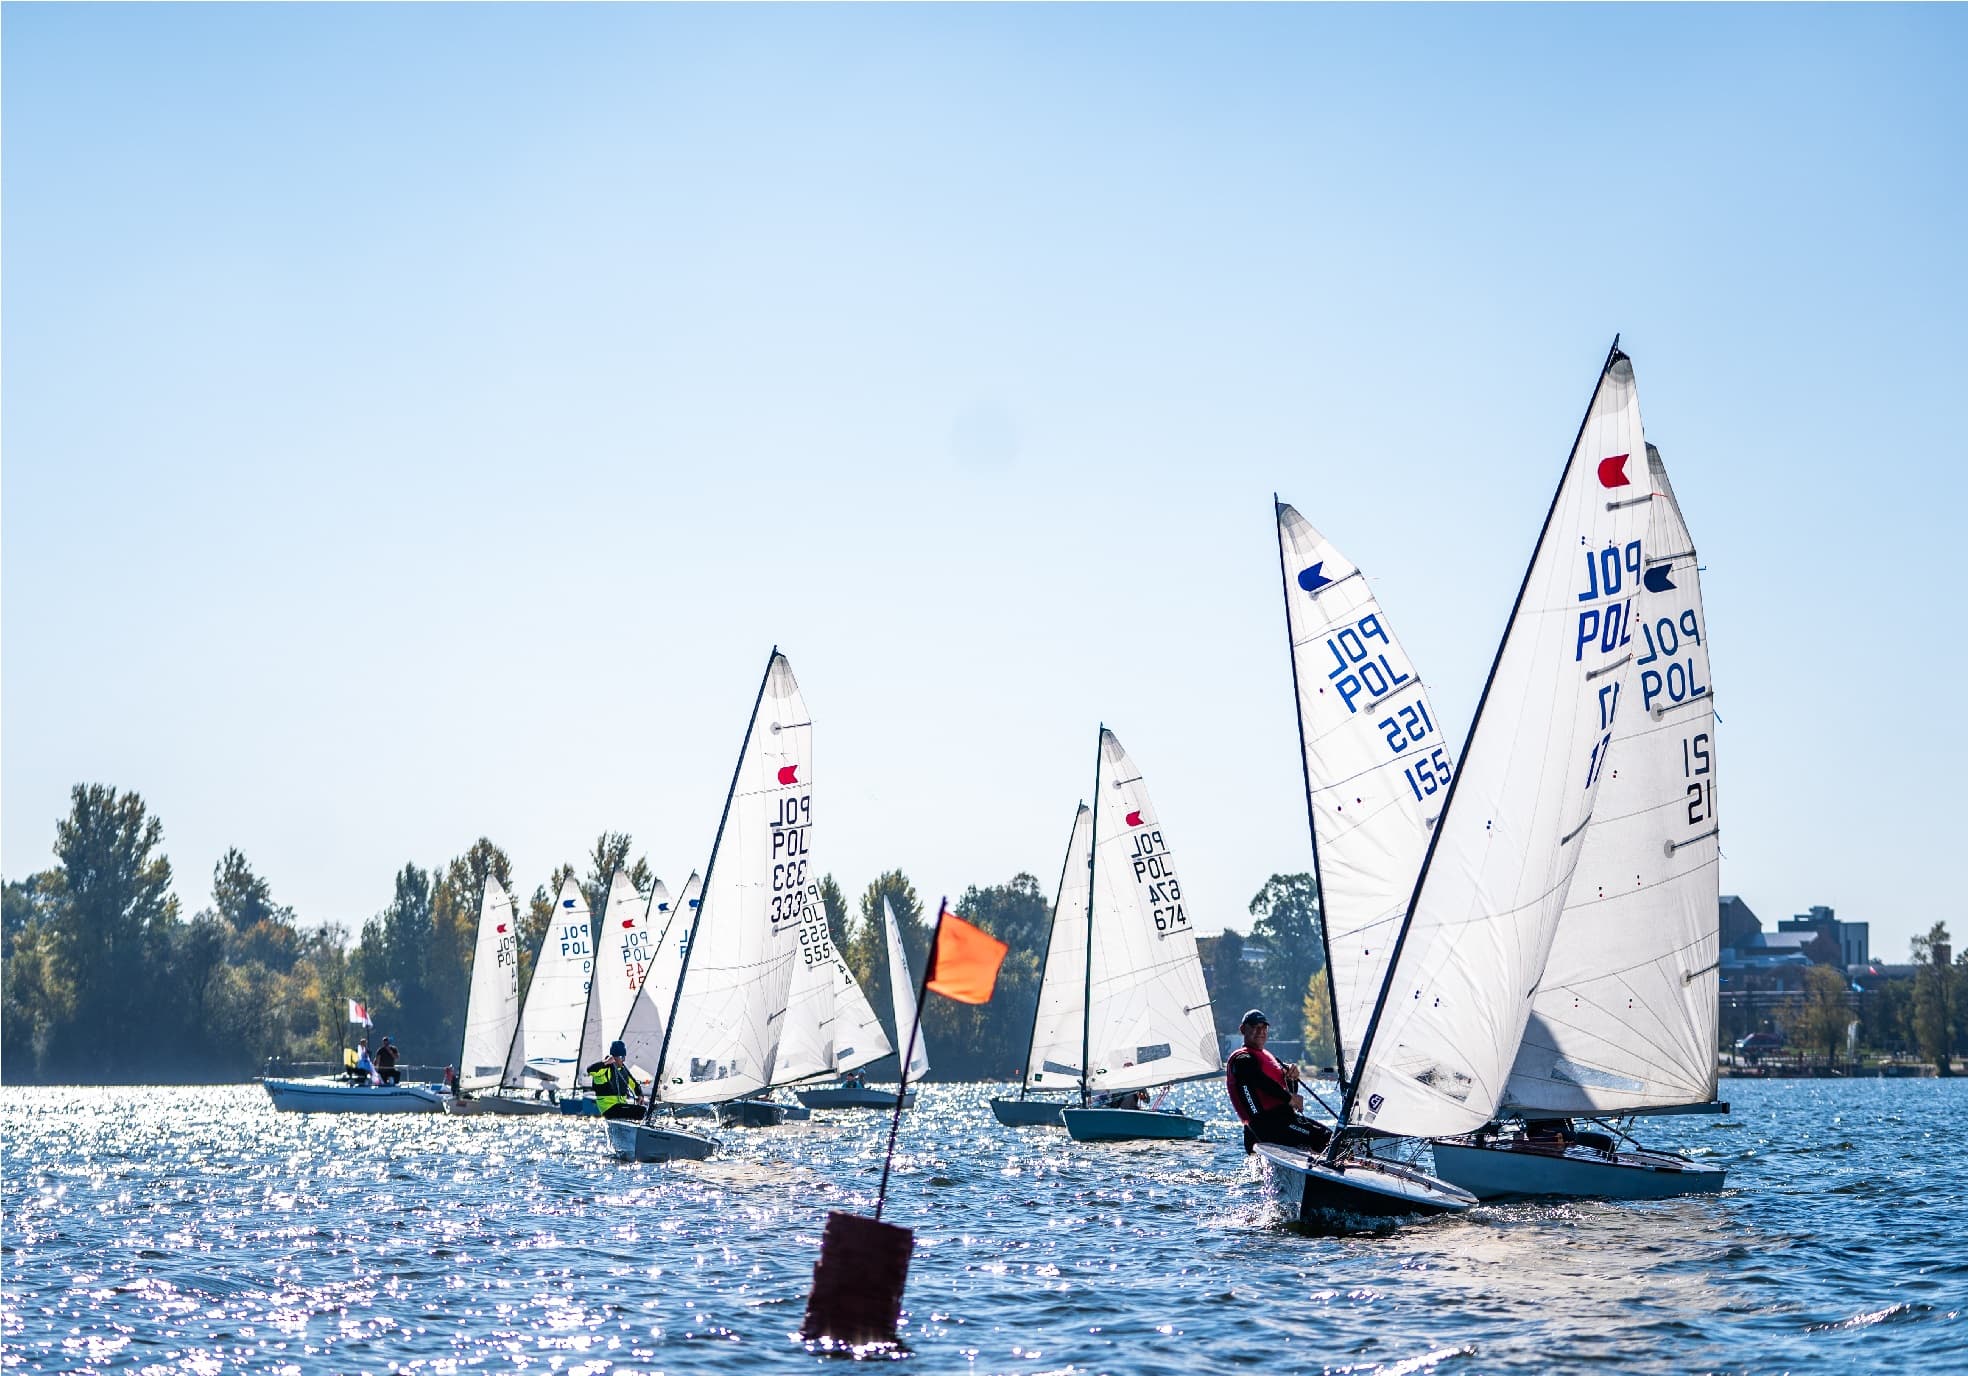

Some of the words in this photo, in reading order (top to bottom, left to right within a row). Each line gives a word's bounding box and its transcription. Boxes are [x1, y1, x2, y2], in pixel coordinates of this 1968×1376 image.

[1576, 599, 1630, 661] POL
[1335, 654, 1410, 713] POL
[1641, 658, 1705, 712] POL
[1404, 748, 1452, 801] 155
[1687, 779, 1711, 825] 21
[773, 829, 808, 859] POL
[1133, 856, 1173, 883] POL
[771, 891, 802, 923] 333
[802, 905, 823, 923] OL
[1154, 903, 1186, 930] 674
[498, 952, 516, 968] POL
[561, 941, 590, 956] POL
[622, 947, 651, 963] POL
[804, 942, 830, 965] 555
